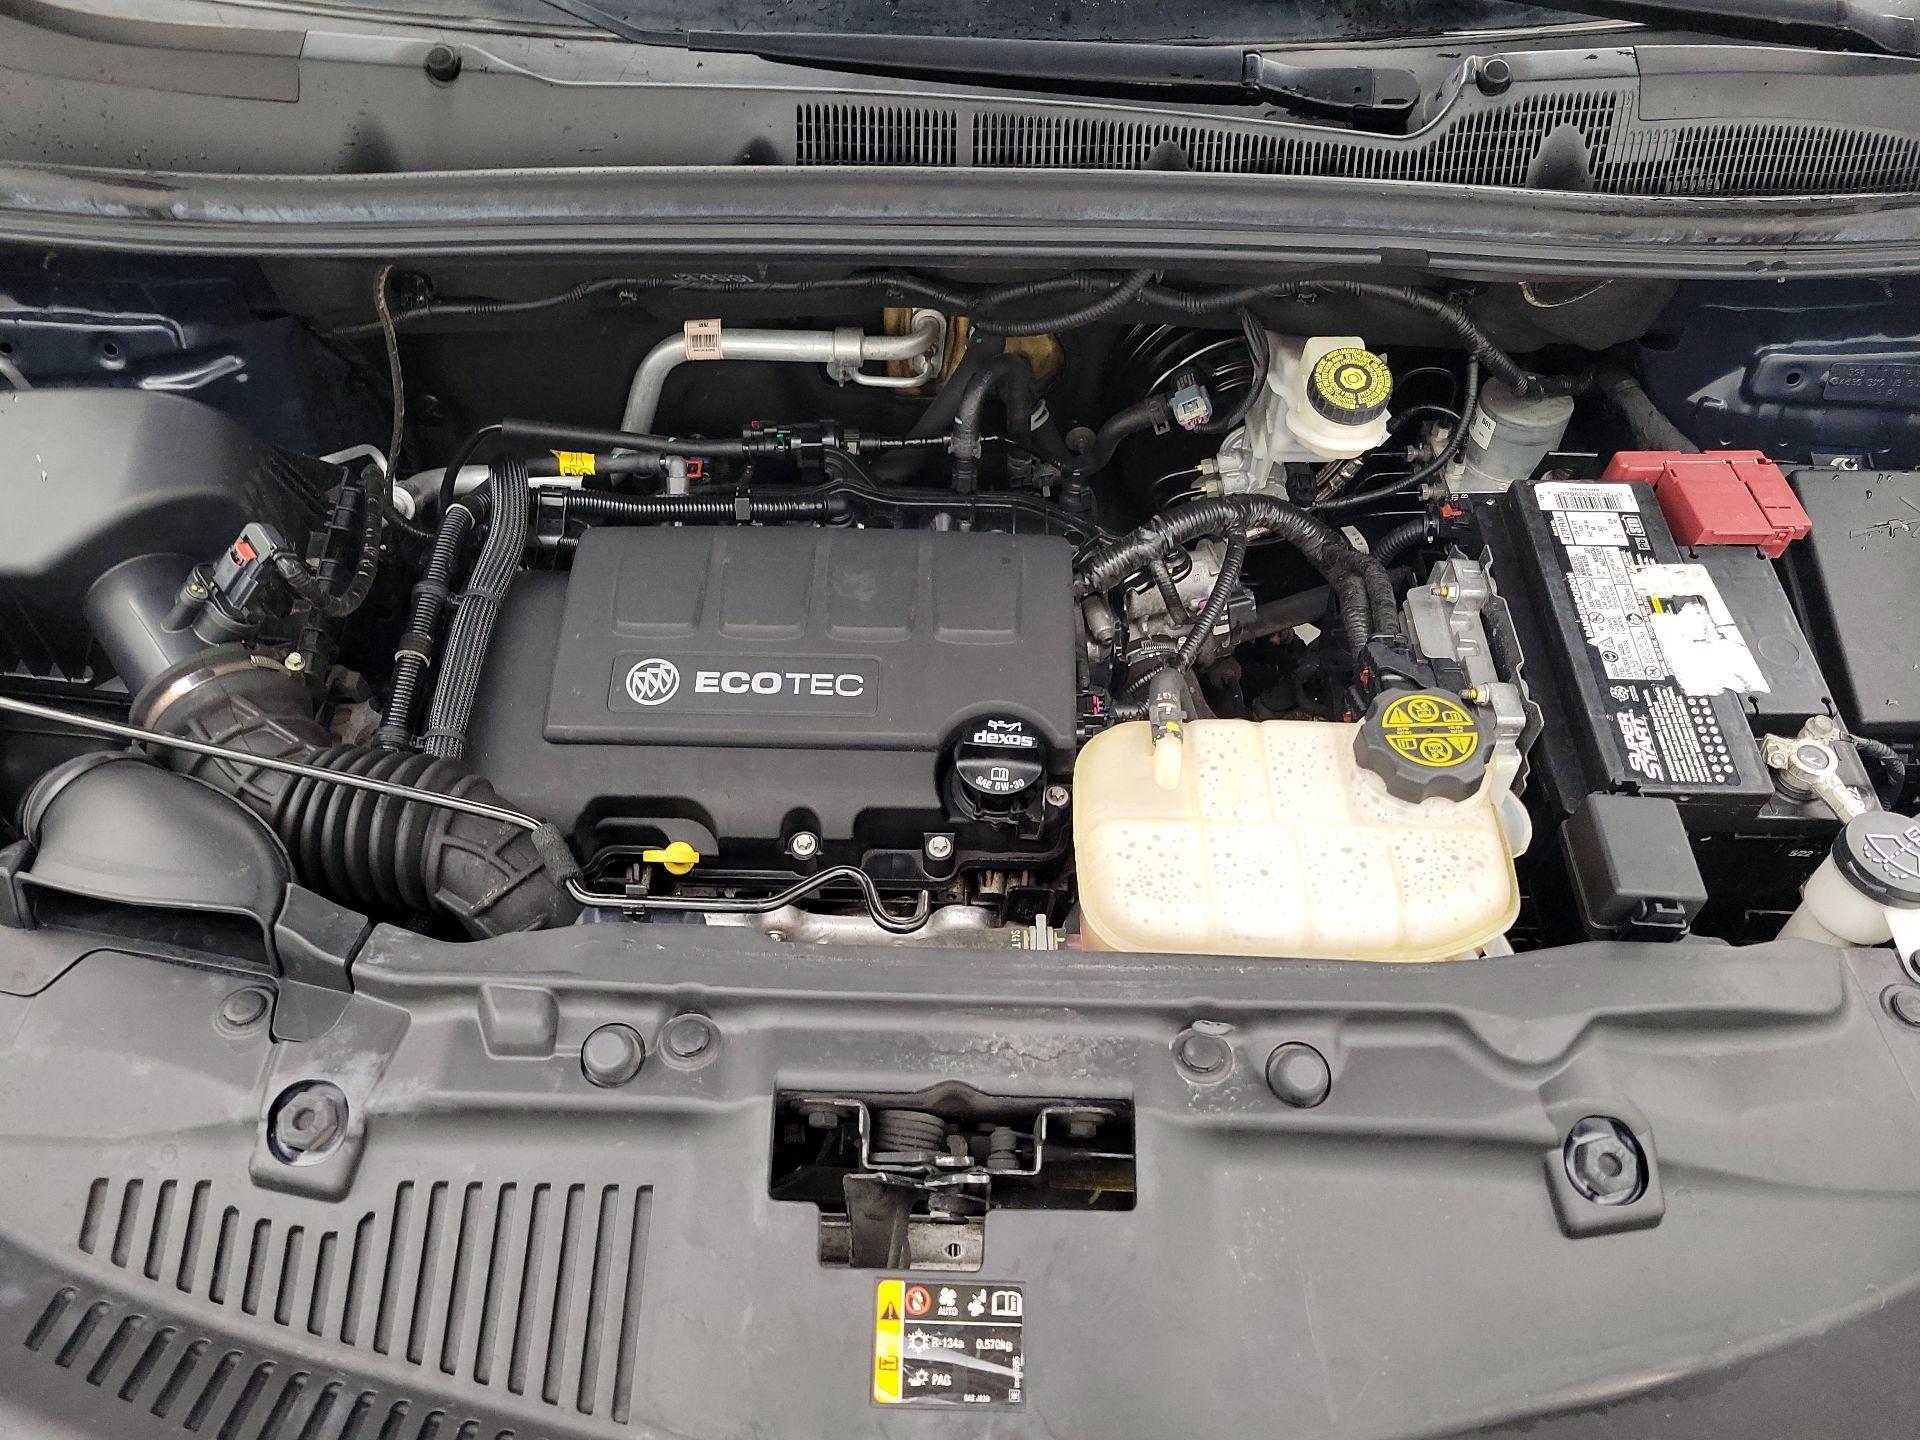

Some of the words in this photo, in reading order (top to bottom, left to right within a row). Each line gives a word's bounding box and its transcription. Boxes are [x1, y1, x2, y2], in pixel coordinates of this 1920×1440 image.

[1639, 538, 1647, 548] Pb
[695, 671, 864, 697] ECOTEC
[973, 730, 1034, 747] dexos
[1617, 710, 1640, 772] SUPER
[975, 776, 992, 790] SAE
[994, 778, 1025, 791] 5W-30
[937, 1306, 959, 1316] AUTO
[931, 1337, 965, 1349] R-134a
[975, 1338, 1013, 1352] 0.570kg
[931, 1373, 952, 1386] PAG
